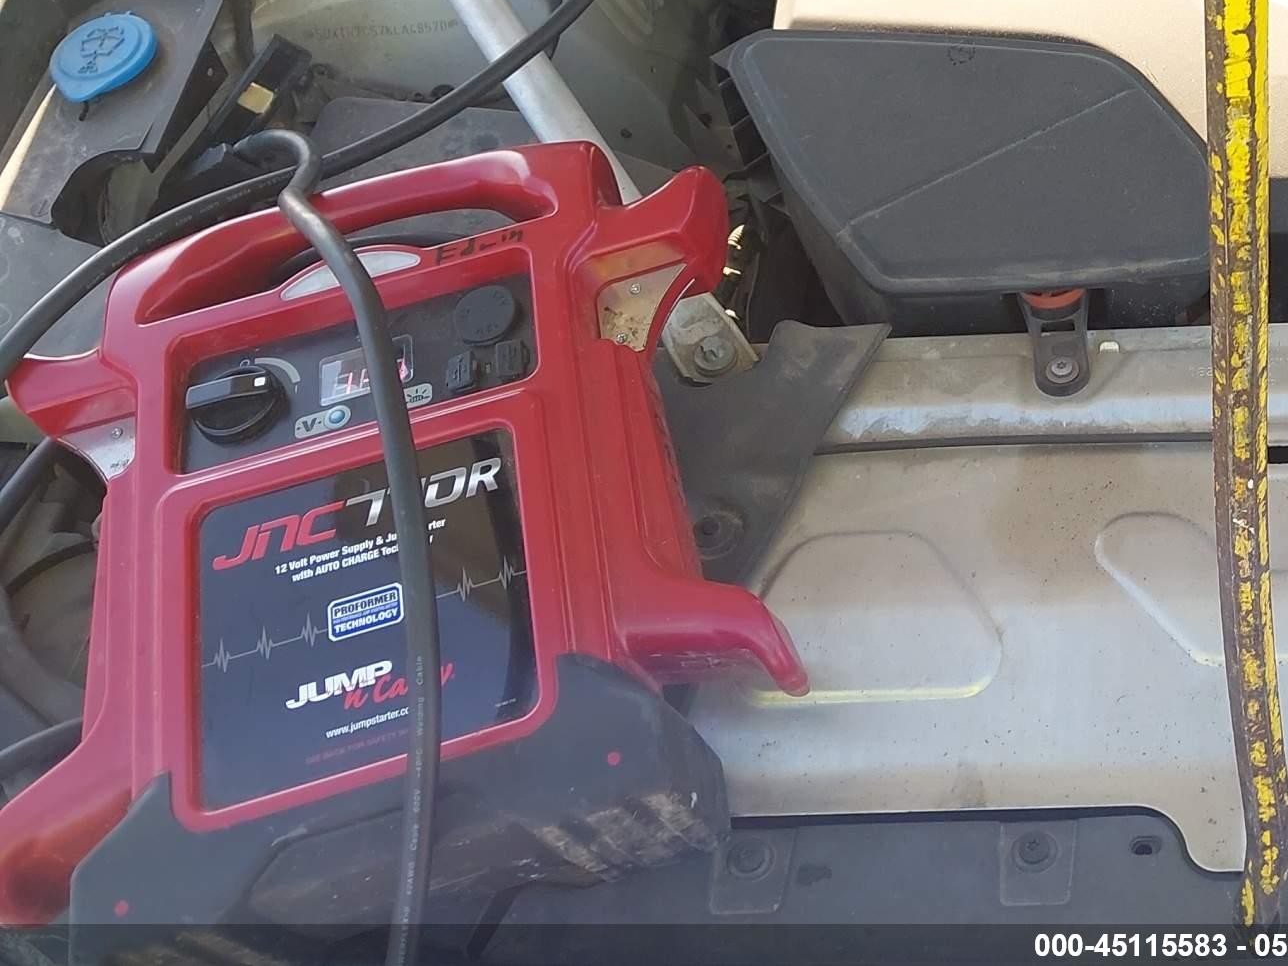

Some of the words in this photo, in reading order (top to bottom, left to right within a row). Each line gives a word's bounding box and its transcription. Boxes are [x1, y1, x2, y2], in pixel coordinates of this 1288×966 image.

[275, 564, 287, 575] 12
[289, 558, 308, 571] Volt
[309, 550, 340, 565] Power
[342, 539, 374, 556] Supply
[375, 534, 384, 547] &
[291, 567, 314, 583] with
[315, 560, 340, 576] AUTO
[342, 550, 379, 568] CHARGE
[334, 591, 398, 617] PROFORMER
[334, 608, 399, 634] TECHNOLOGY
[285, 660, 393, 709] JUMP
